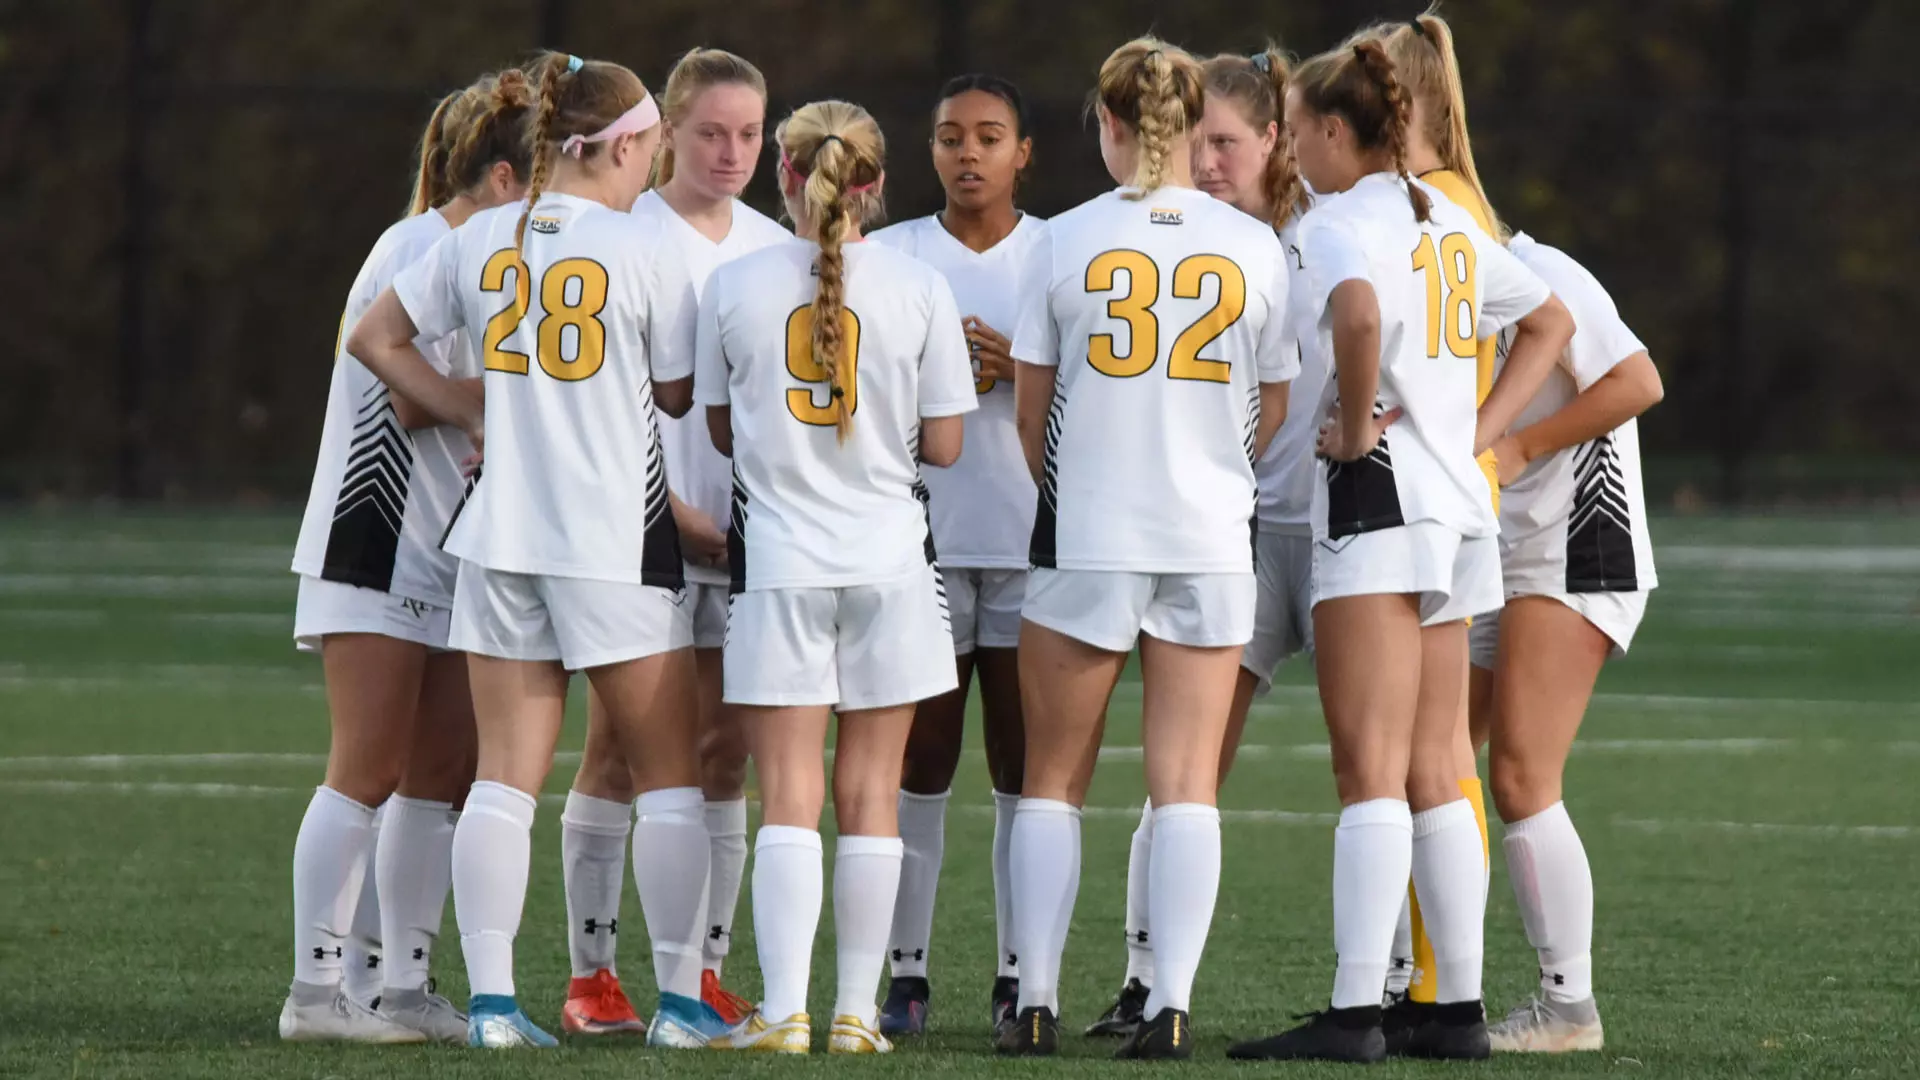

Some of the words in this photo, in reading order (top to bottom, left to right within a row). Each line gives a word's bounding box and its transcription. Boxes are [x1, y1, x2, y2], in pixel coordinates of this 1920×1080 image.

[531, 219, 561, 230] PSAC
[1150, 211, 1183, 222] PSAC
[479, 247, 610, 382] 28
[1084, 248, 1247, 384] 32
[1411, 232, 1478, 359] 18
[785, 302, 861, 427] 9
